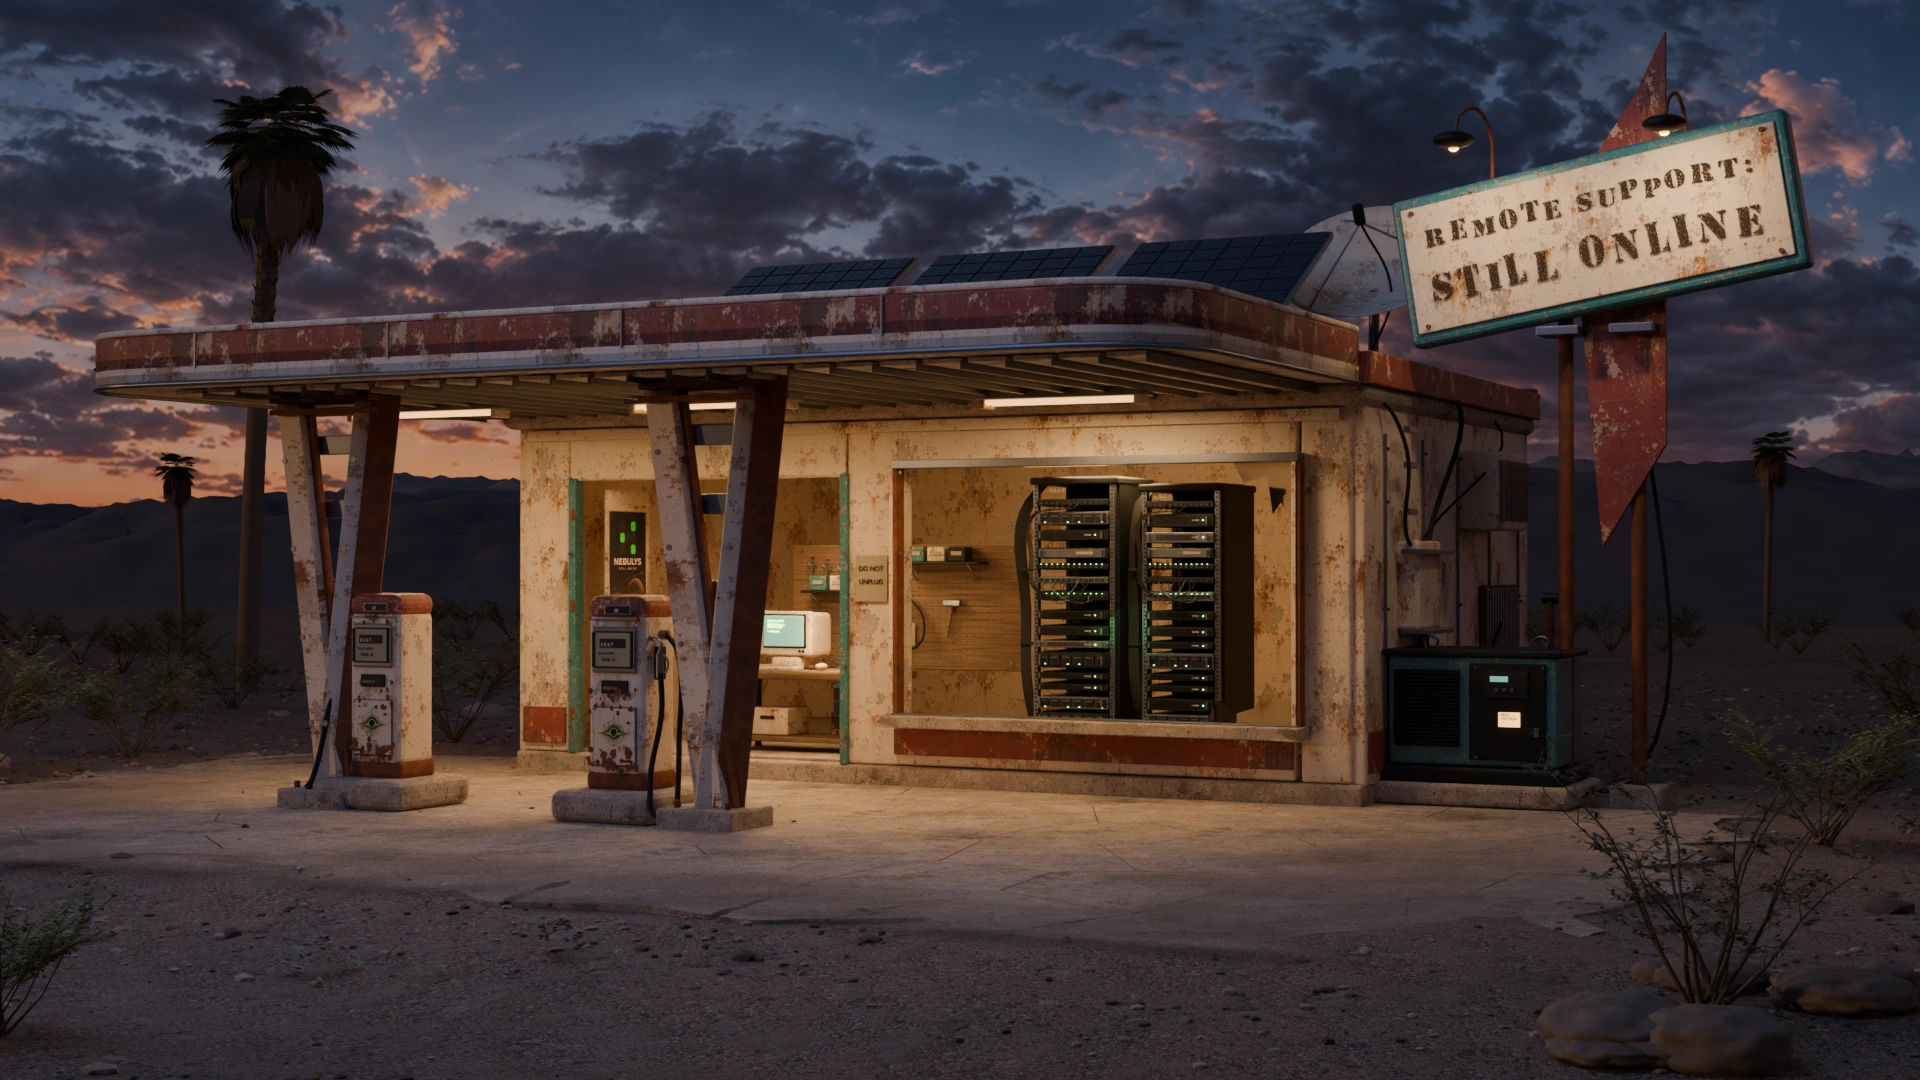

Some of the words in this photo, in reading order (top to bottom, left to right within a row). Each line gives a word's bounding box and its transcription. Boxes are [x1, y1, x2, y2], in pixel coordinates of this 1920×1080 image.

[1425, 200, 1562, 248] REMOTE
[1577, 158, 1754, 213] SUPPORT:
[1432, 250, 1560, 302] STILL
[1579, 204, 1764, 269] ONLINE
[613, 557, 642, 566] NEBULYS
